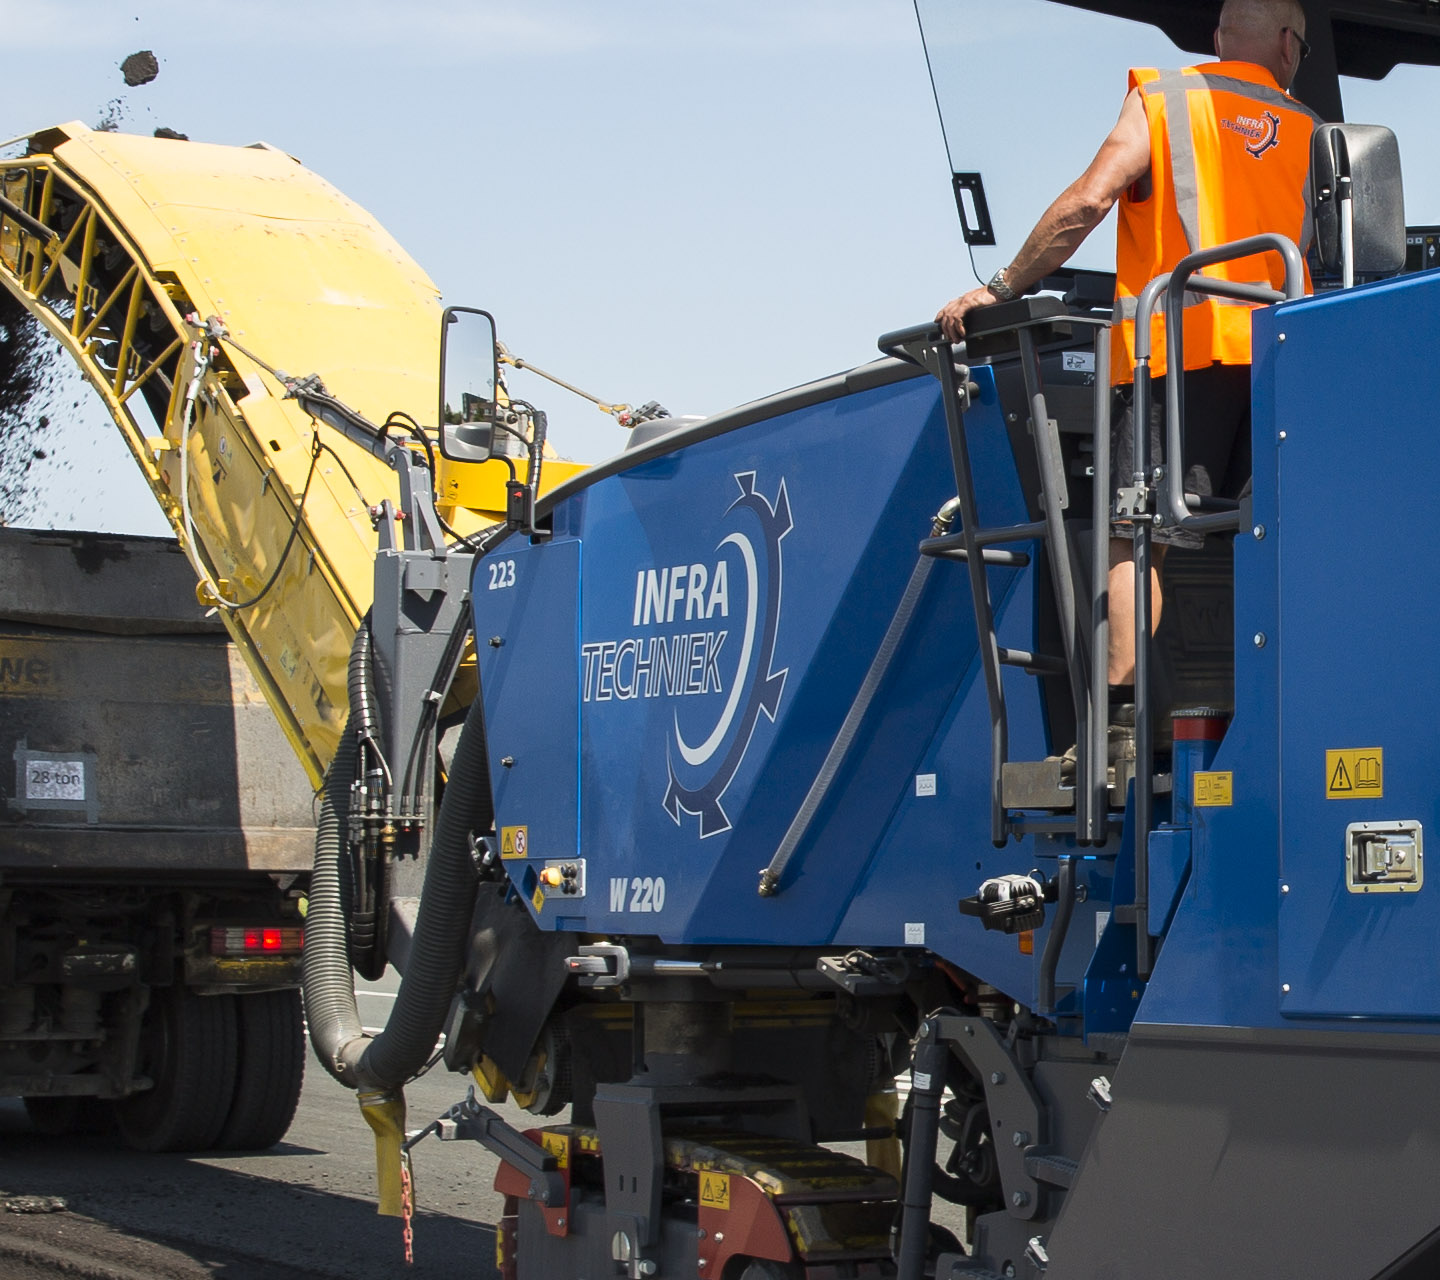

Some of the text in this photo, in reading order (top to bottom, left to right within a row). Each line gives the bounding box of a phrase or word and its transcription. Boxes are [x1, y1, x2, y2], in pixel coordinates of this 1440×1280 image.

[1221, 119, 1262, 138] TECHNIEK
[1236, 115, 1264, 129] INFRA
[488, 559, 516, 591] 223
[633, 560, 729, 626] INFRA
[581, 630, 729, 703] TECHNIEK
[32, 770, 80, 785] 28 ton
[610, 876, 665, 913] W 220
